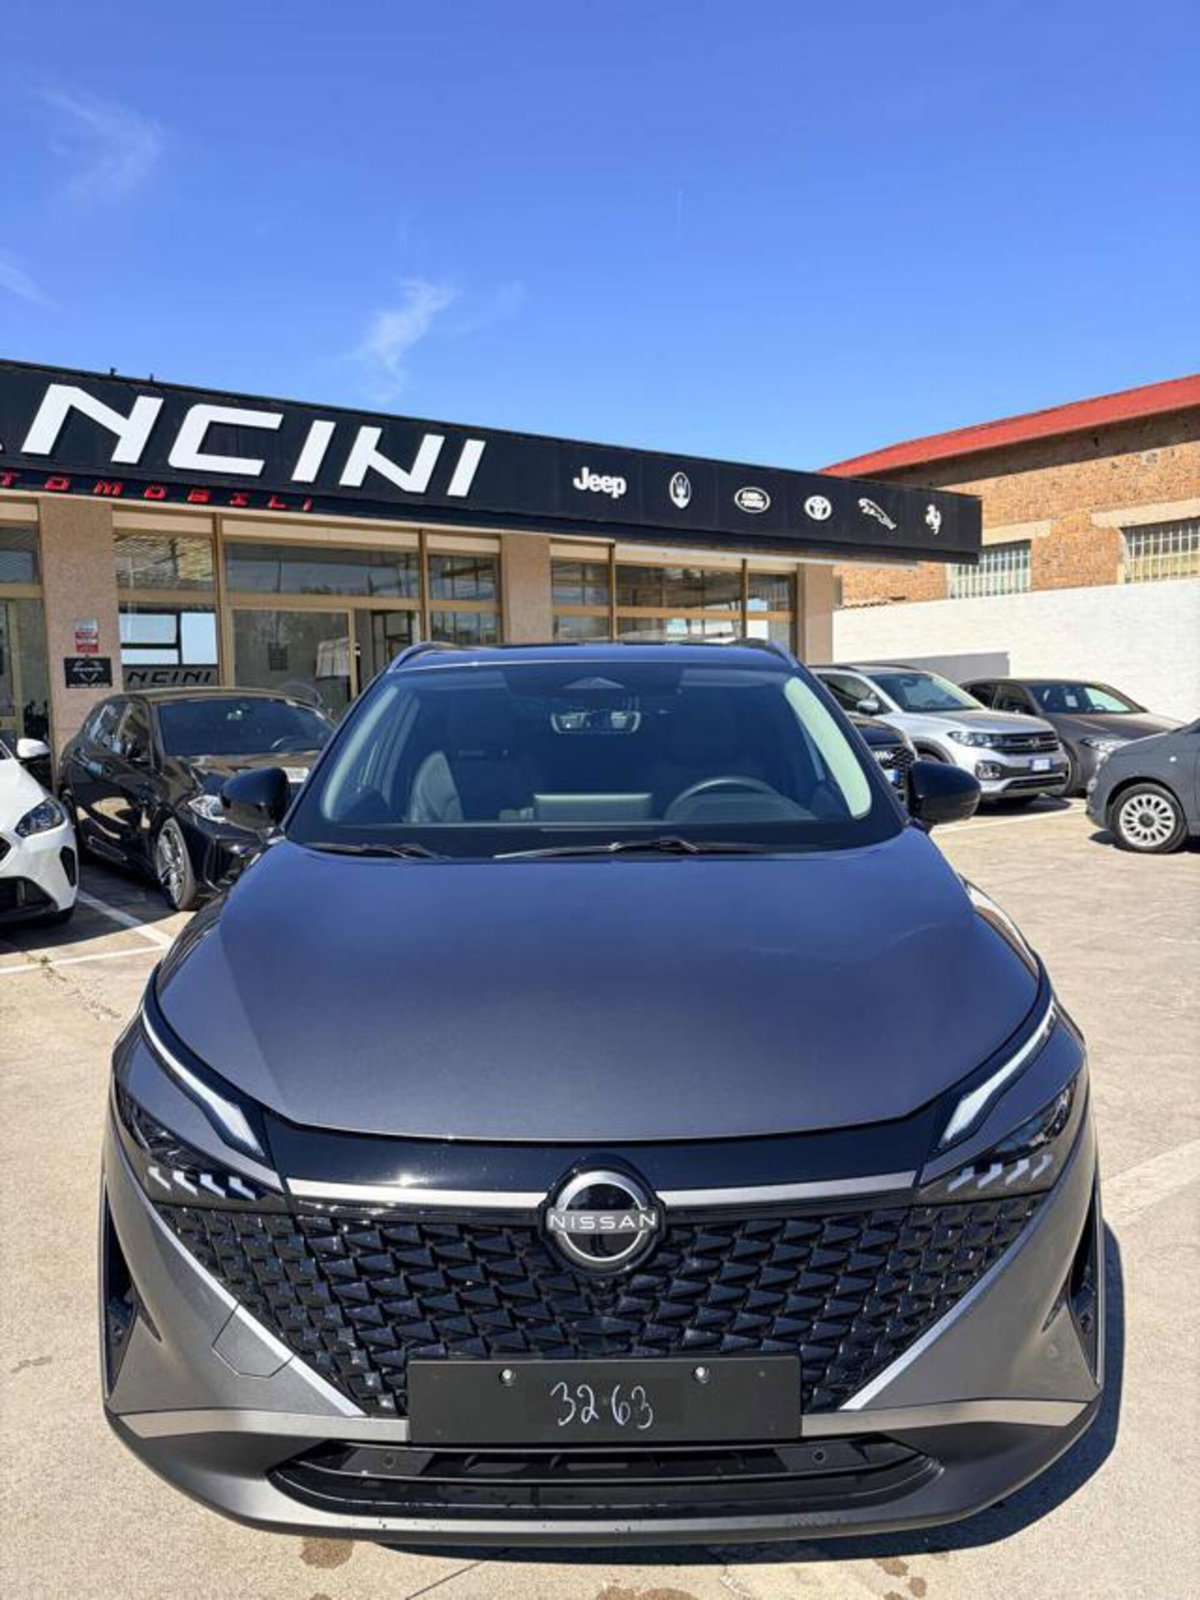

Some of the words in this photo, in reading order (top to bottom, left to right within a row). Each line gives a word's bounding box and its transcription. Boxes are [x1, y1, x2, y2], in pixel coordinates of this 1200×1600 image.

[0, 384, 486, 498] NCINI
[573, 466, 627, 499] Jeep
[549, 1213, 656, 1230] NISSAN
